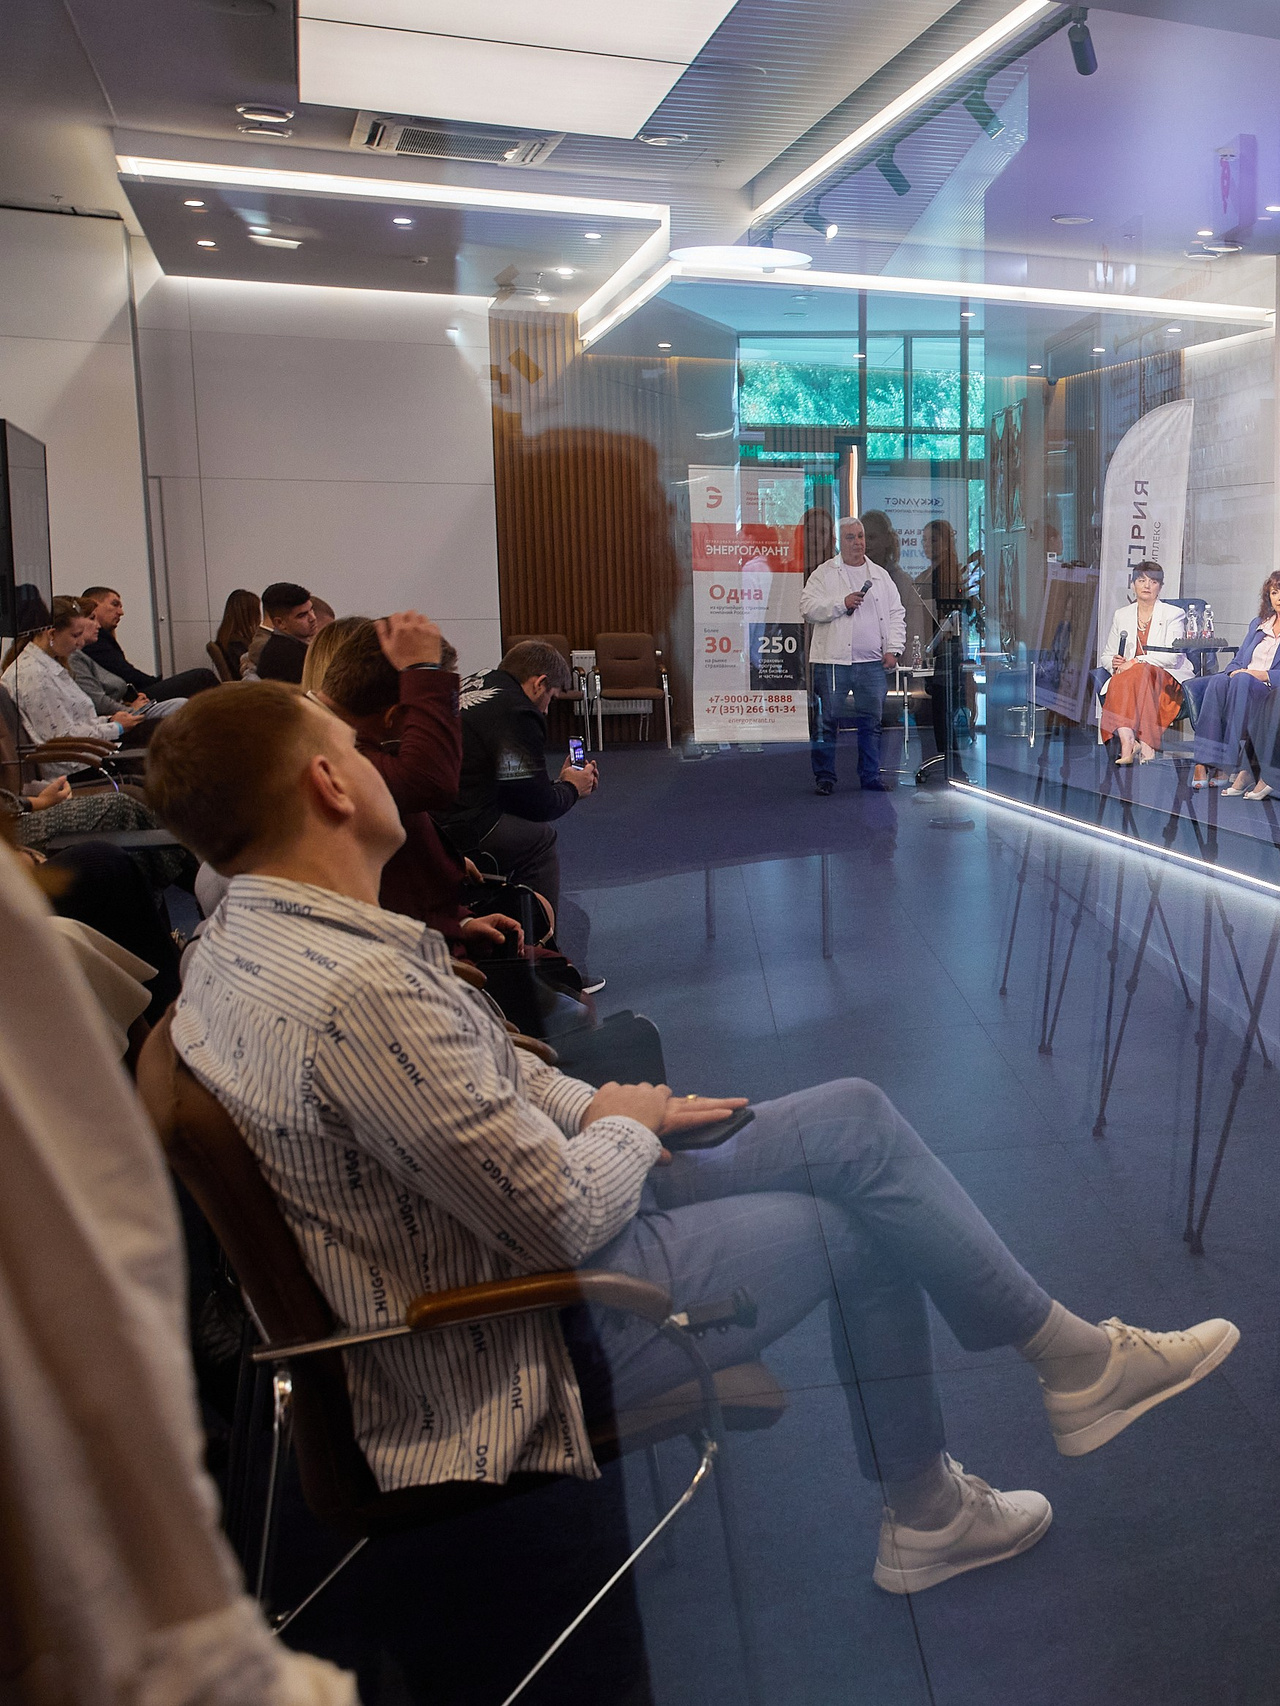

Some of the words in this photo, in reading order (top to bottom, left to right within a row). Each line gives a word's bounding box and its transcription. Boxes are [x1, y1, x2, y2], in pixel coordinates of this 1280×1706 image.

[705, 544, 790, 557] ЭНЕРГОГАРАНТ
[709, 584, 763, 604] Одна
[705, 636, 732, 654] 30
[757, 636, 797, 654] 250
[708, 695, 793, 704] +7-9000-77-8888
[705, 706, 717, 714] +7
[719, 705, 744, 716] (351)
[746, 705, 797, 714] 266-61-34
[301, 947, 338, 971] HUGO
[389, 1041, 424, 1087] HUGO
[483, 1158, 519, 1200] HUGO
[369, 1265, 388, 1312] HUGO
[476, 1446, 489, 1482] UGO
